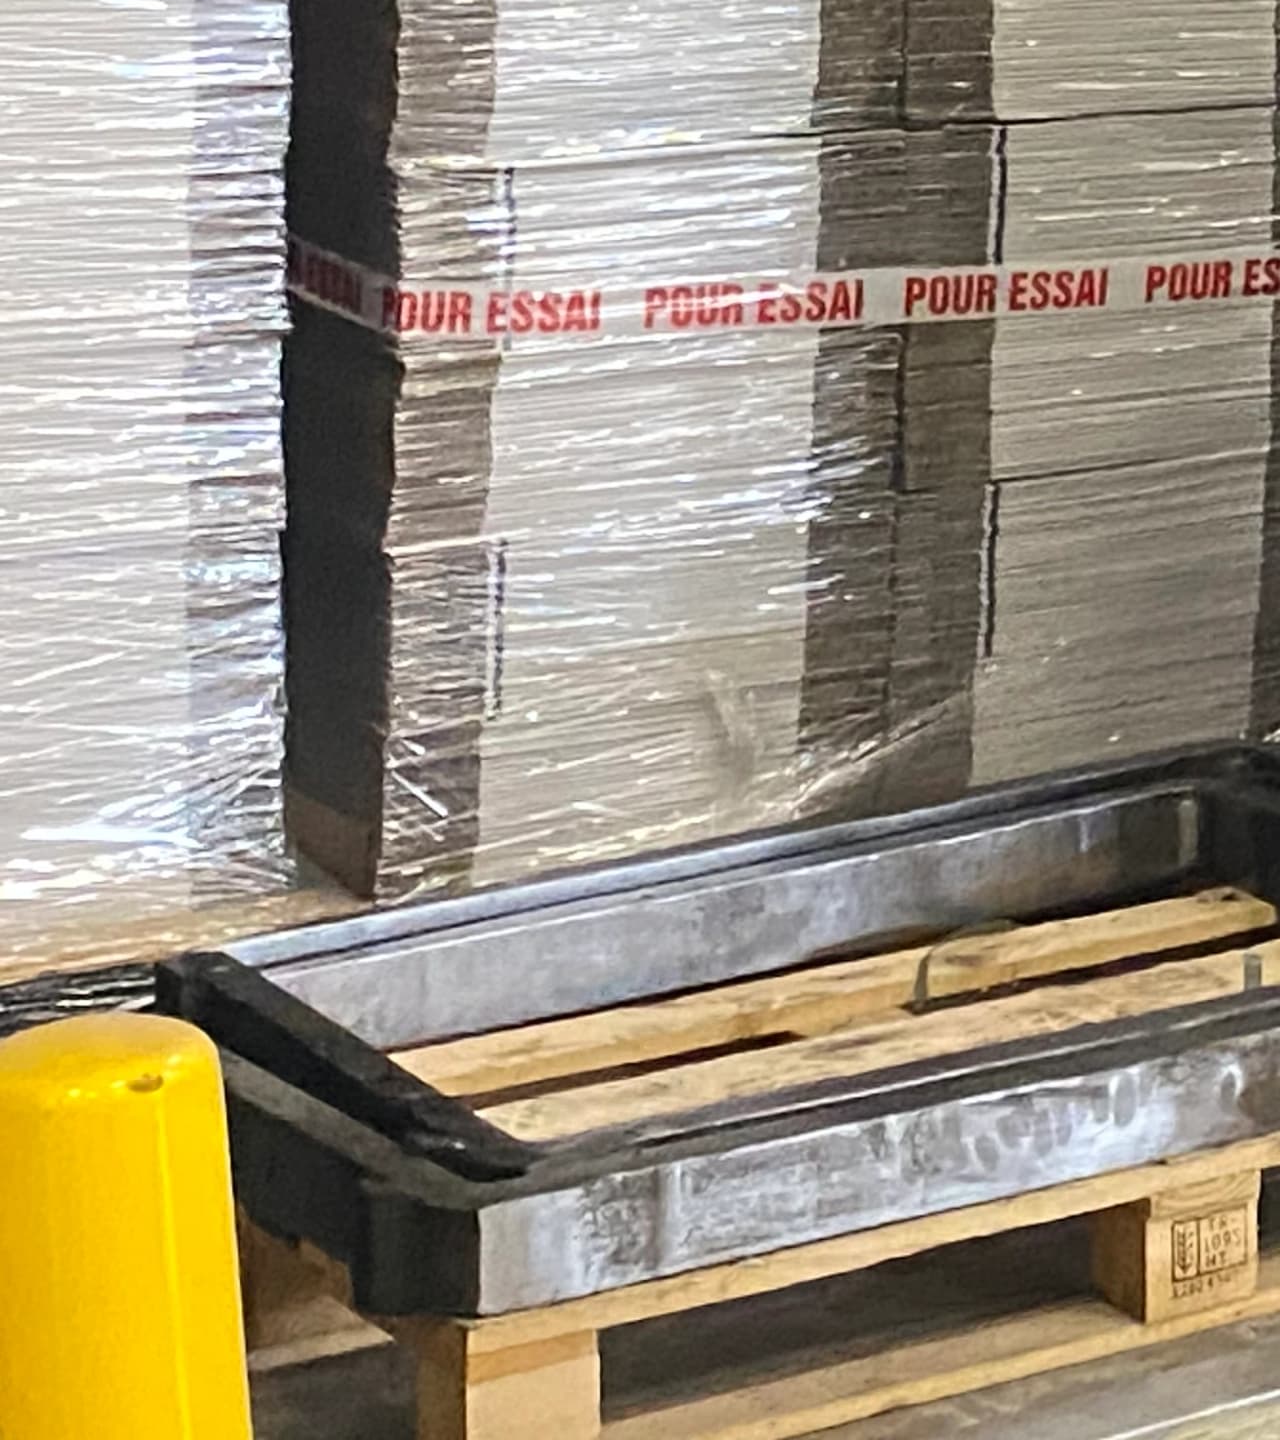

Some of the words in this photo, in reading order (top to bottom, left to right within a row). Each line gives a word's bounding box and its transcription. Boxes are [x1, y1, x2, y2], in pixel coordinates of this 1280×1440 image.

[486, 288, 601, 333] ESSAI
[643, 283, 744, 328] POUR
[757, 277, 864, 324] ESSAI
[904, 273, 997, 317] POUR
[1008, 267, 1109, 311] ESSAI
[1145, 261, 1232, 303] POUR
